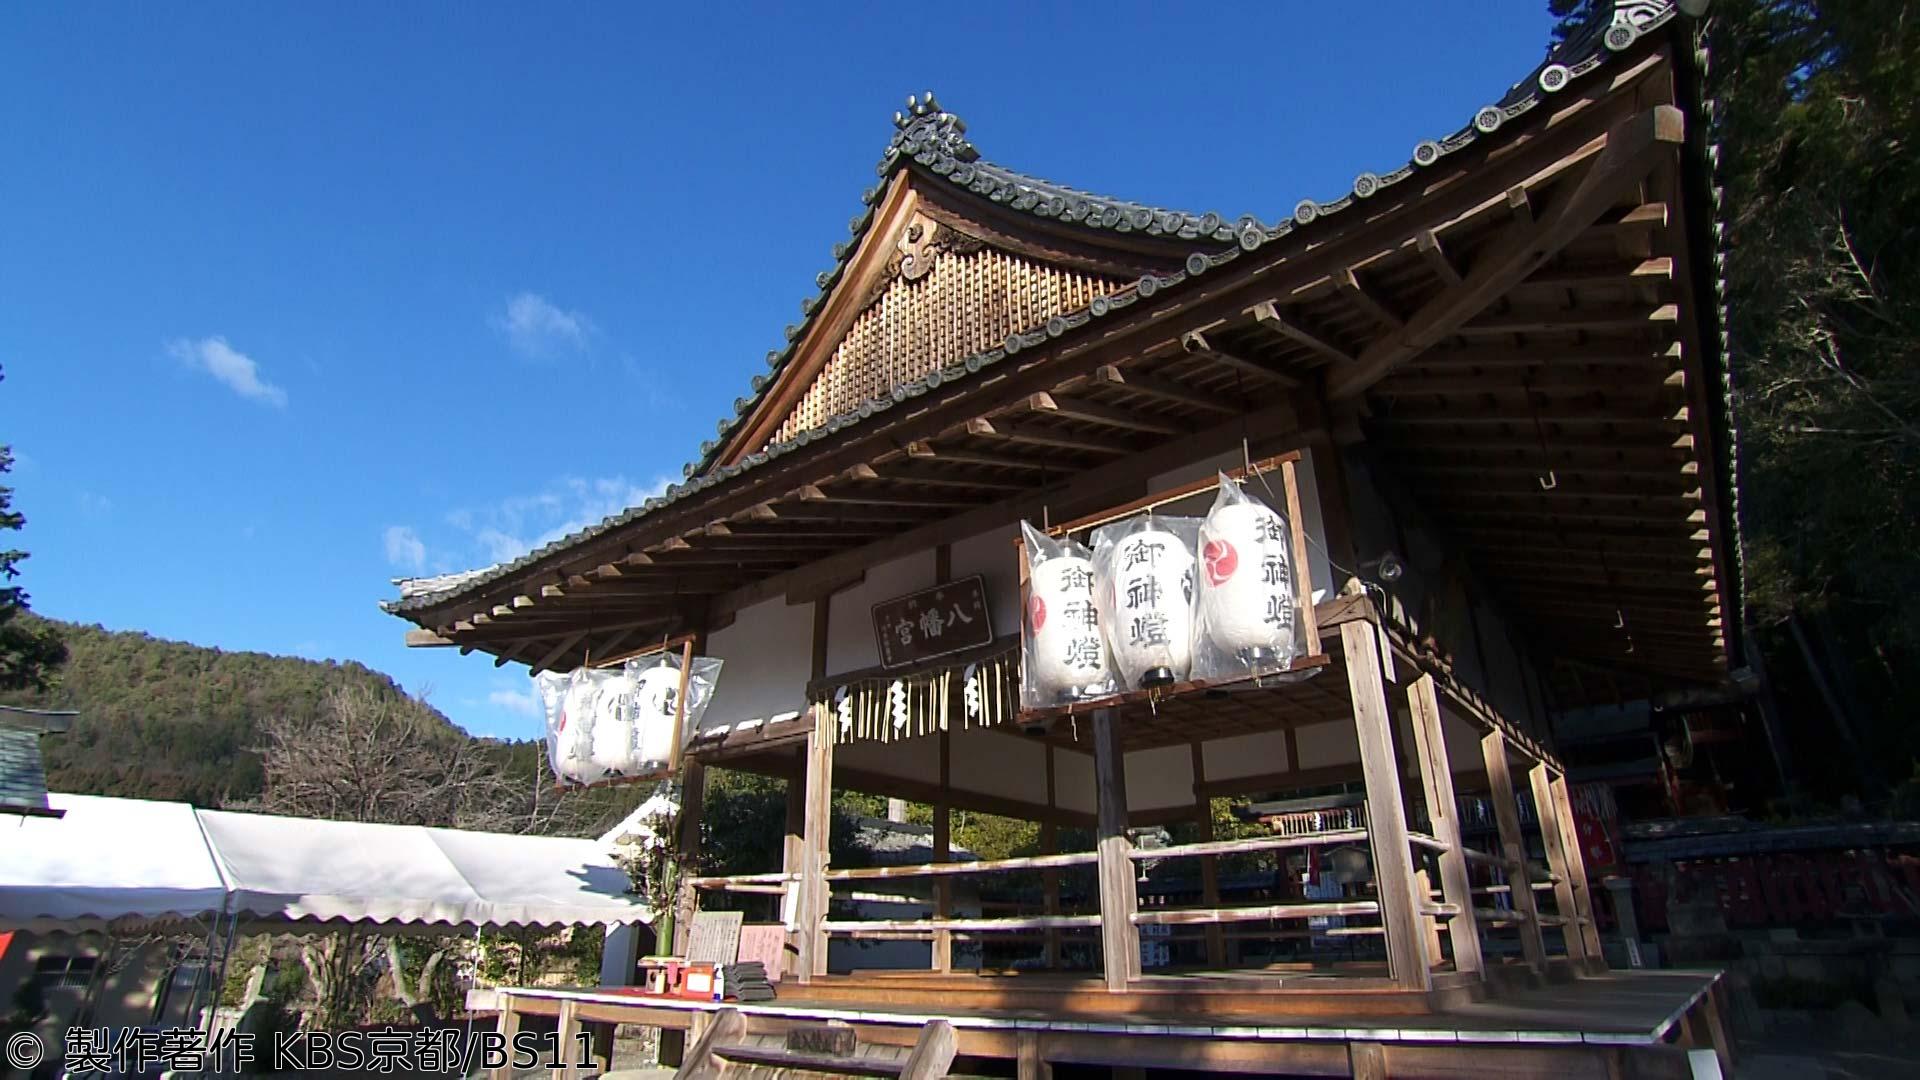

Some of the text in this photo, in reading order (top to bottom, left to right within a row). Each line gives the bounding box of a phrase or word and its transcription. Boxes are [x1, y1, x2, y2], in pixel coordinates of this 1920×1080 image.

[895, 602, 975, 647] 八幡宮
[1060, 564, 1102, 671] 御神燈
[1124, 538, 1171, 649] 御神燈
